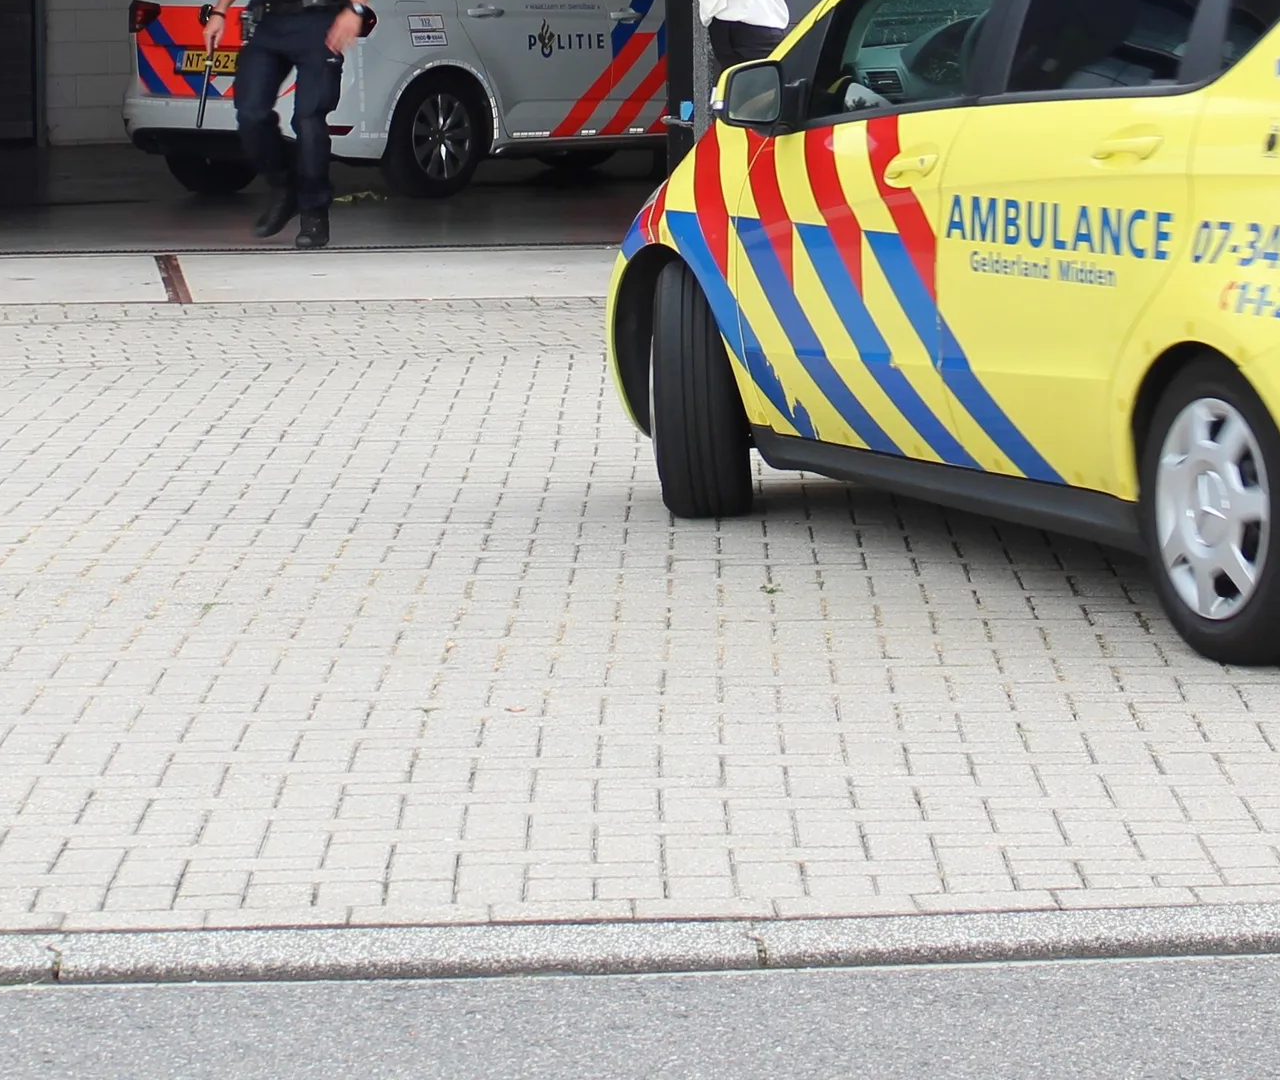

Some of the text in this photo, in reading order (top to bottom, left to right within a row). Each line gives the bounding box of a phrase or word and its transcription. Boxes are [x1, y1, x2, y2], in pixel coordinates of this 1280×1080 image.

[185, 52, 239, 69] NT-62-
[528, 31, 605, 58] POLITIE
[945, 194, 1174, 261] AMBULANCE
[970, 250, 1117, 287] Gelderland Midden
